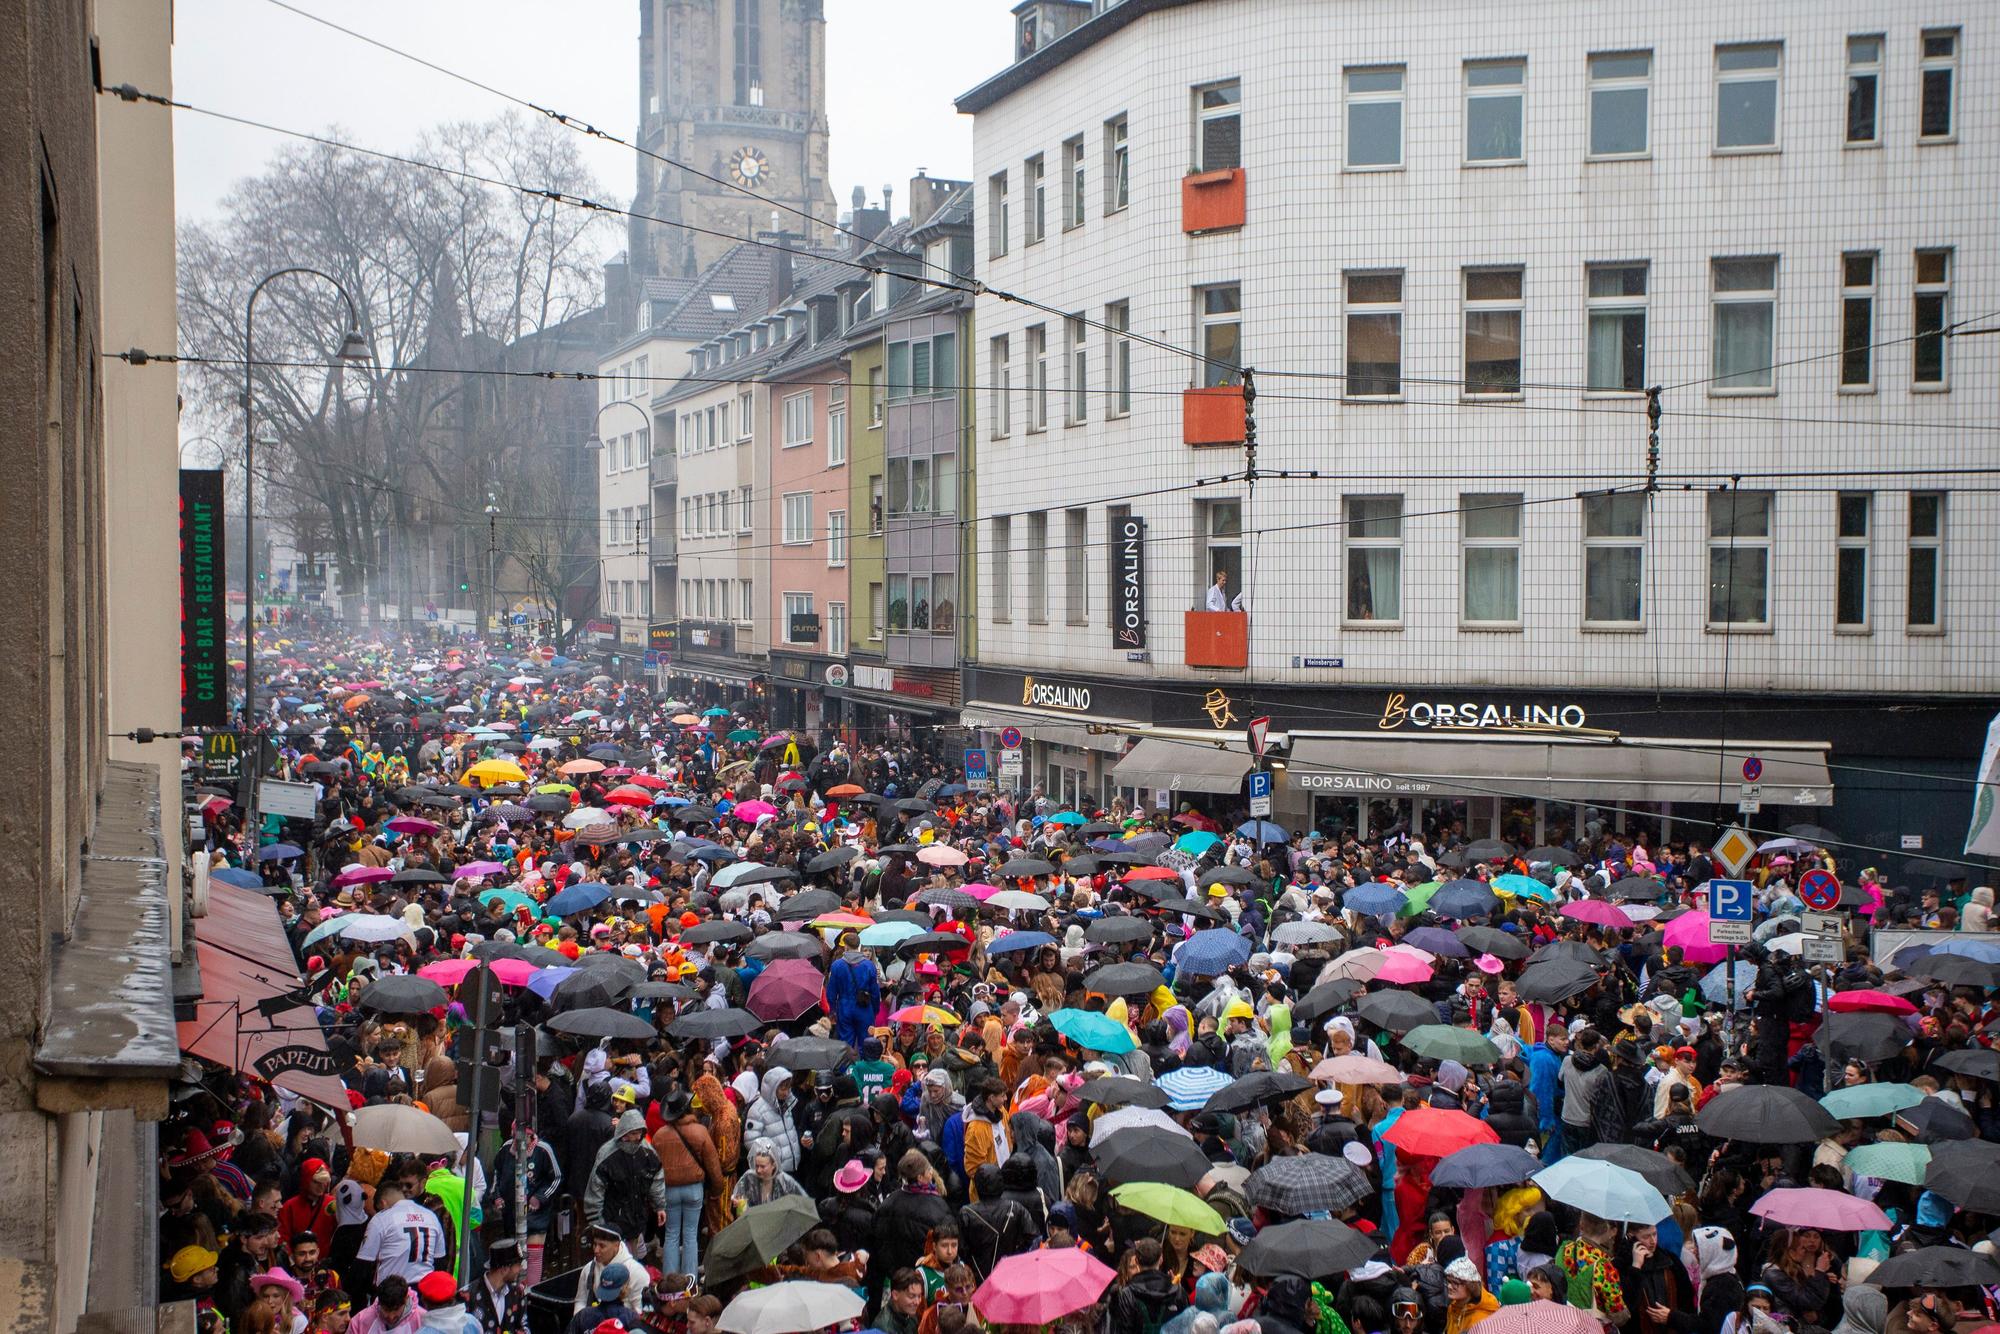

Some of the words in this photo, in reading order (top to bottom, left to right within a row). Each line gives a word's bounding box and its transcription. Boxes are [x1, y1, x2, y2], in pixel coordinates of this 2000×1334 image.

[194, 502, 213, 603] RESTAURANT
[1119, 522, 1140, 646] BORSALINO
[196, 617, 214, 647] BAR
[193, 662, 215, 701] CAFÉ
[1022, 675, 1090, 710] BORSALINO
[1378, 692, 1586, 730] BORSALINO
[968, 771, 985, 779] TAXI
[1254, 776, 1266, 795] P
[1301, 775, 1392, 791] BORSALINO
[1396, 783, 1410, 791] seit
[1411, 784, 1431, 792] 1987
[1716, 885, 1739, 915] P
[863, 1073, 884, 1082] MARINO
[403, 1226, 430, 1263] 11
